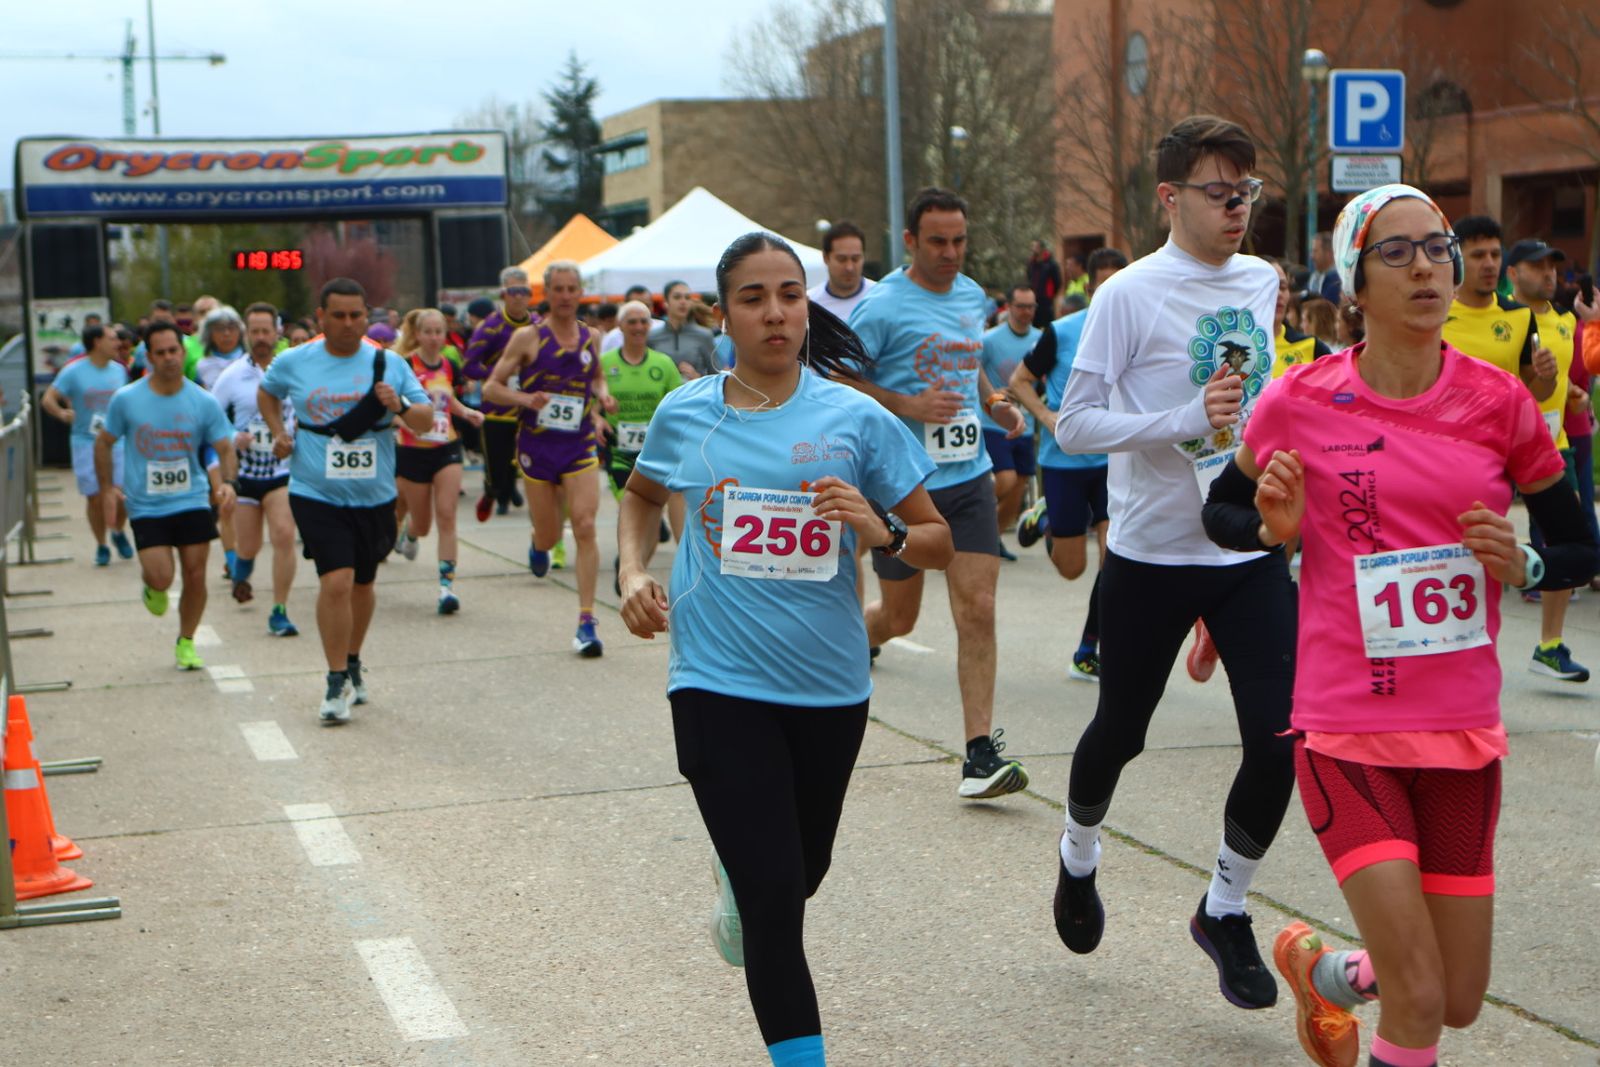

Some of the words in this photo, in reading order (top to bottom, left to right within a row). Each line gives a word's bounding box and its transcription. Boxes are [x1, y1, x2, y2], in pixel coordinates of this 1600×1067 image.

[1346, 80, 1390, 142] P
[43, 141, 486, 179] OrycronSport
[91, 183, 447, 205] www.orycronsport.com
[549, 404, 574, 421] 35
[932, 424, 978, 450] 139
[332, 450, 373, 469] 363
[1321, 443, 1367, 454] LABORAL
[151, 469, 188, 486] 390
[763, 493, 789, 504] POPULAR
[1338, 468, 1374, 543] 2024
[731, 514, 832, 558] 256
[1370, 554, 1399, 568] CARRERA
[1401, 550, 1430, 565] POPULAR
[1373, 572, 1478, 629] 163
